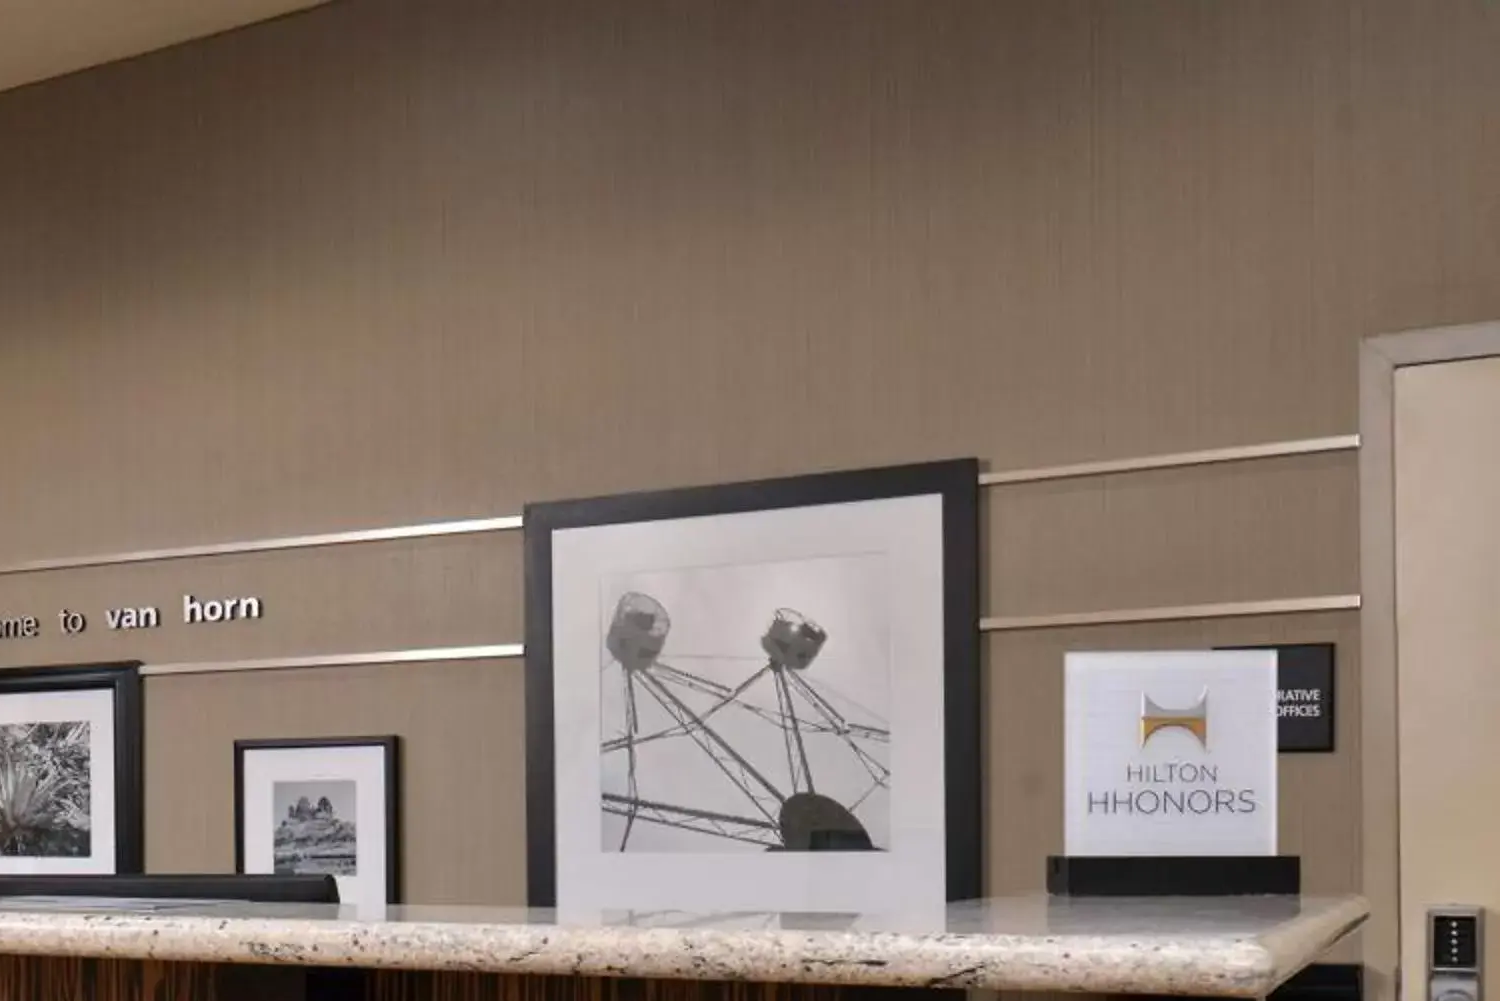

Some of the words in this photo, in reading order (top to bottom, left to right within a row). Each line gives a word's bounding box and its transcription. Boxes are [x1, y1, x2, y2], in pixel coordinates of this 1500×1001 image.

[59, 608, 86, 634] to
[105, 605, 160, 630] van
[182, 594, 261, 624] horn
[1126, 763, 1218, 783] HILTON
[1088, 789, 1256, 814] HHONORS
